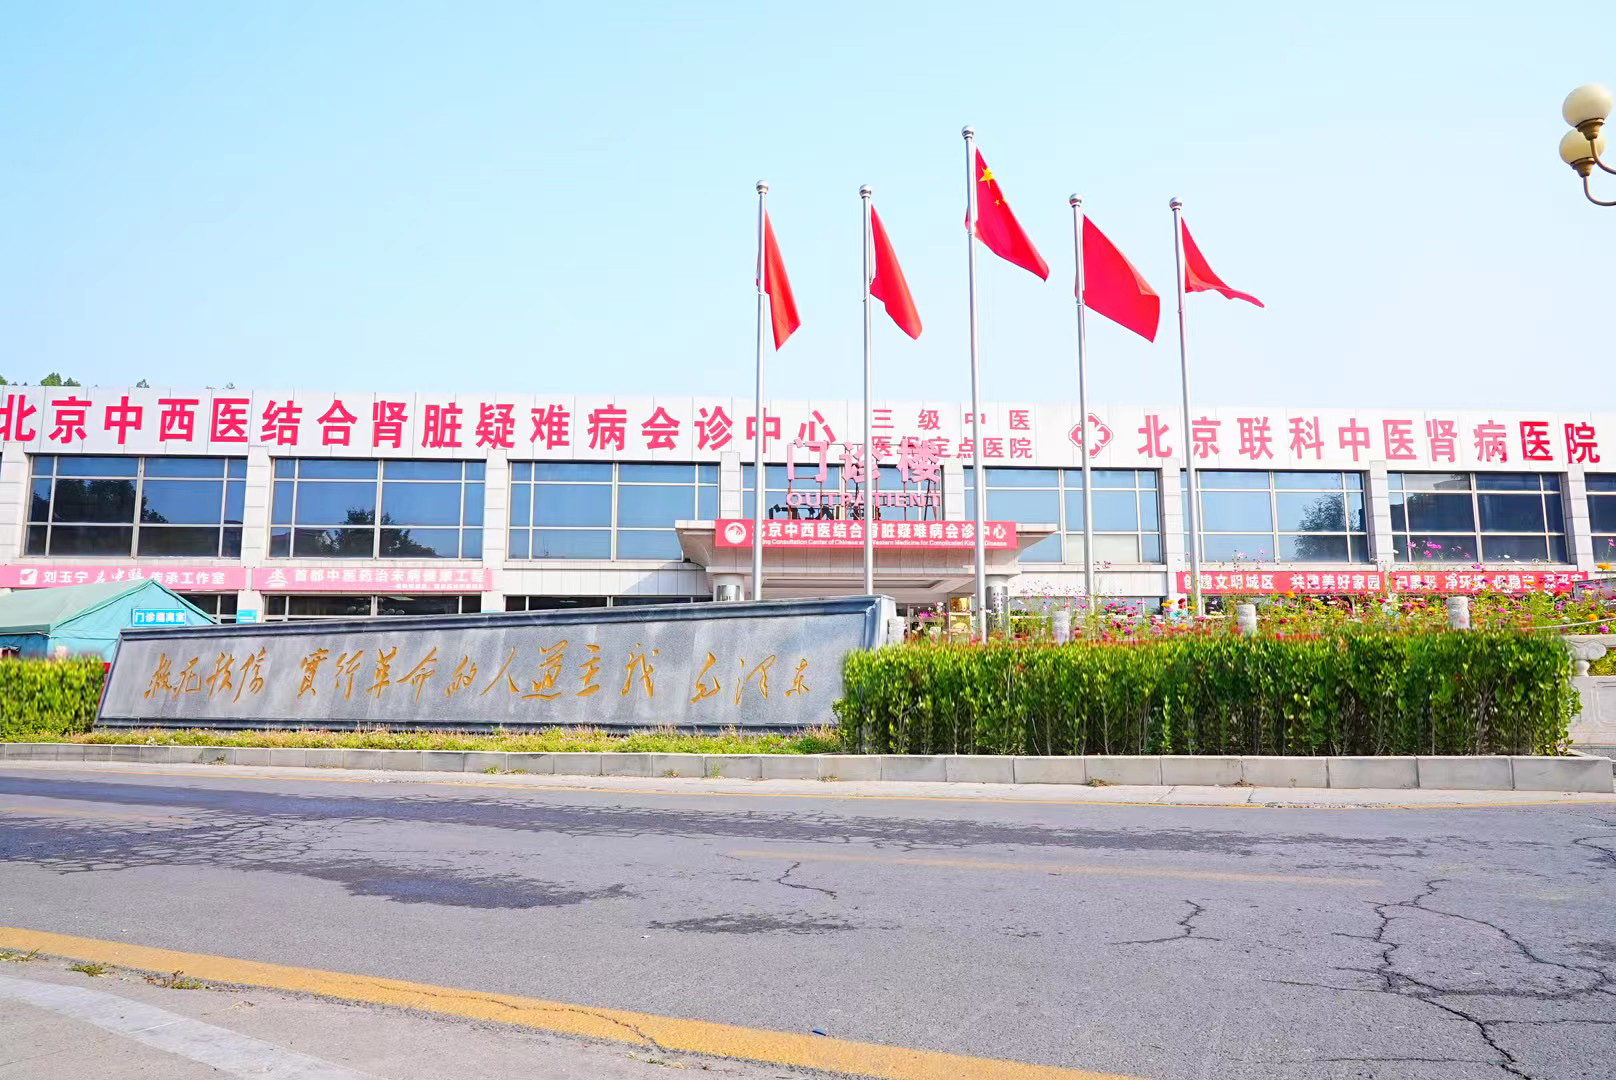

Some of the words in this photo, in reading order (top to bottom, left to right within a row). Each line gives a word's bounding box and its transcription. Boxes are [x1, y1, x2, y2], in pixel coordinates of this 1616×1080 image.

[0, 393, 836, 454] 北京中西医结合肾脏疑难病会诊中心
[872, 409, 1031, 431] 三级中医
[1137, 414, 1601, 464] 北京联科中医肾病医院
[786, 437, 942, 484] 门诊楼
[786, 491, 942, 508] OUTPATIENT
[1290, 573, 1381, 591] 共建美好家园
